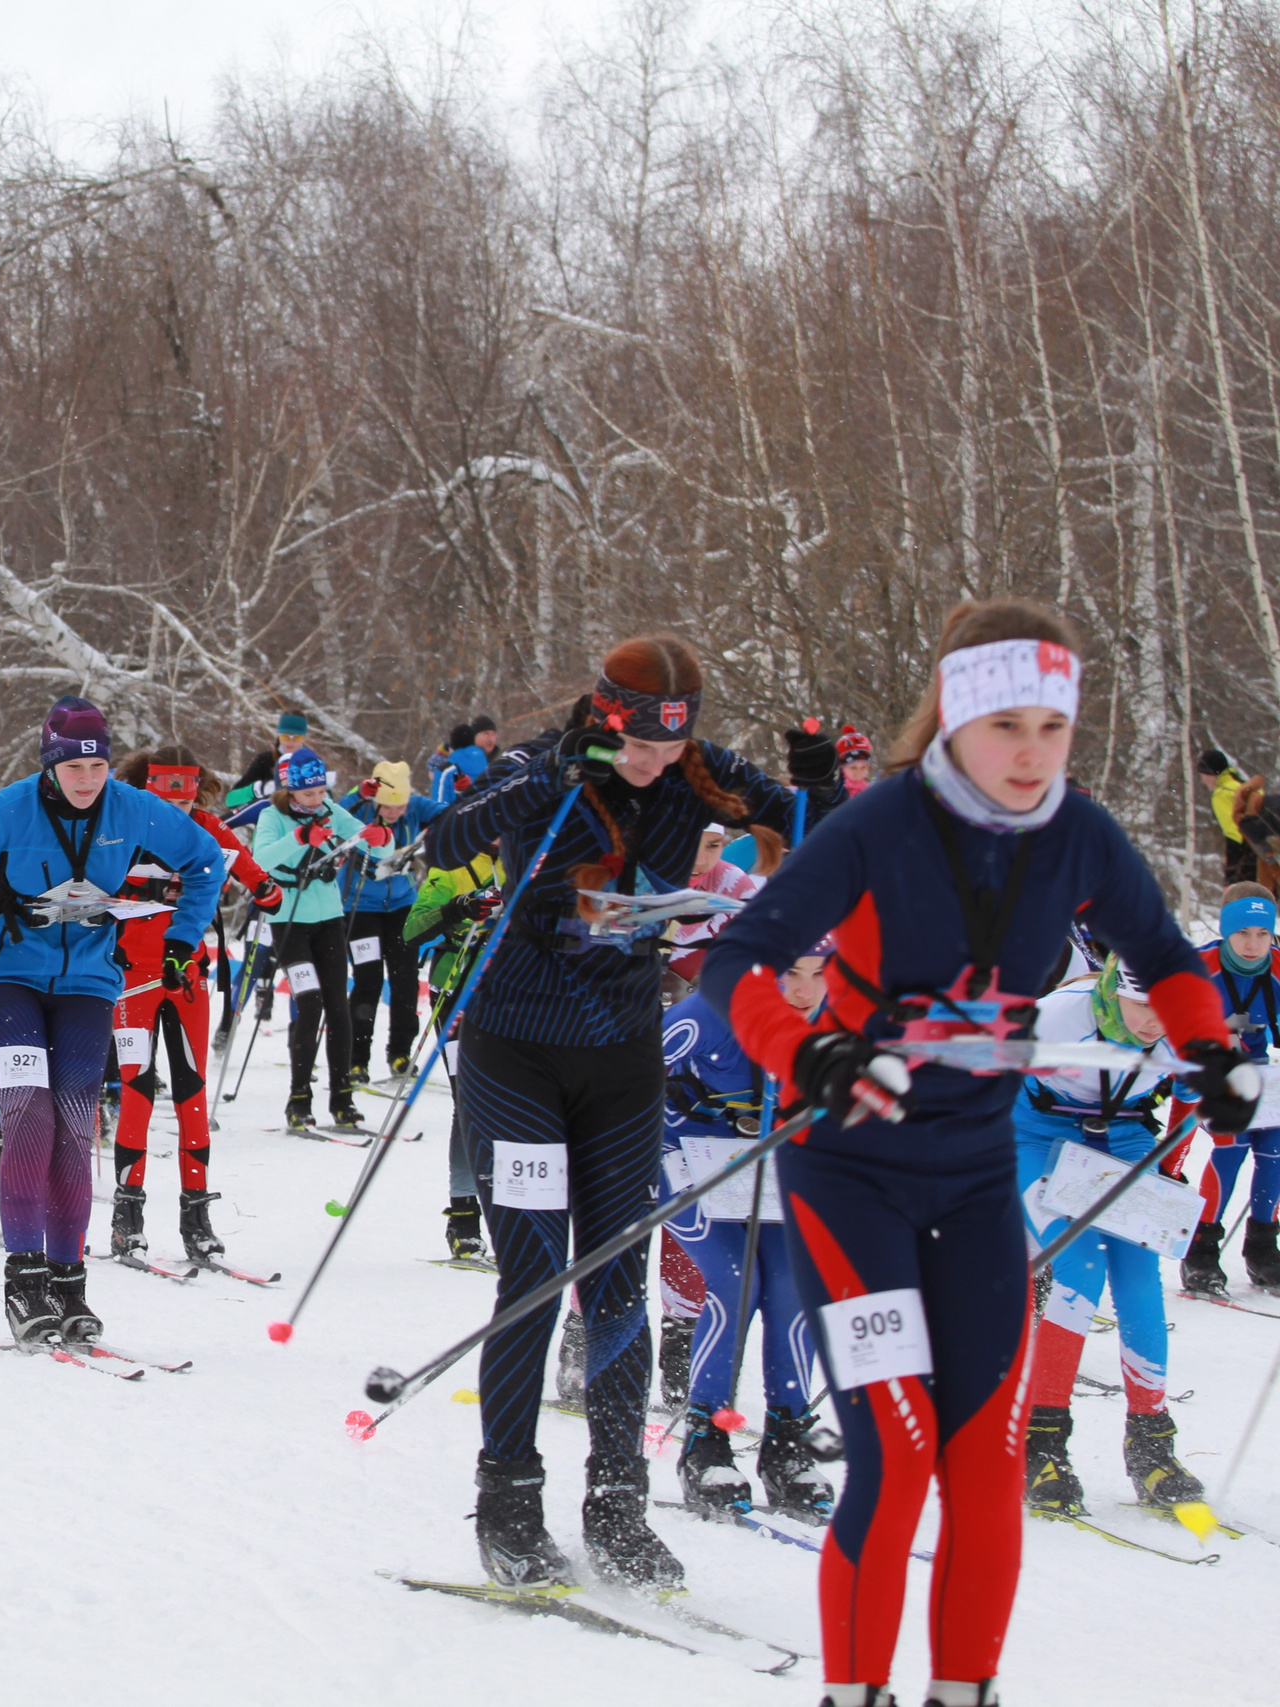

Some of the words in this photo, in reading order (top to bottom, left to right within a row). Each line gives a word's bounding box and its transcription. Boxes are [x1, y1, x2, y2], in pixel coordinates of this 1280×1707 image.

[294, 970, 311, 980] 954
[12, 1054, 38, 1067] 927
[512, 1160, 549, 1179] 918
[851, 1309, 903, 1340] 909
